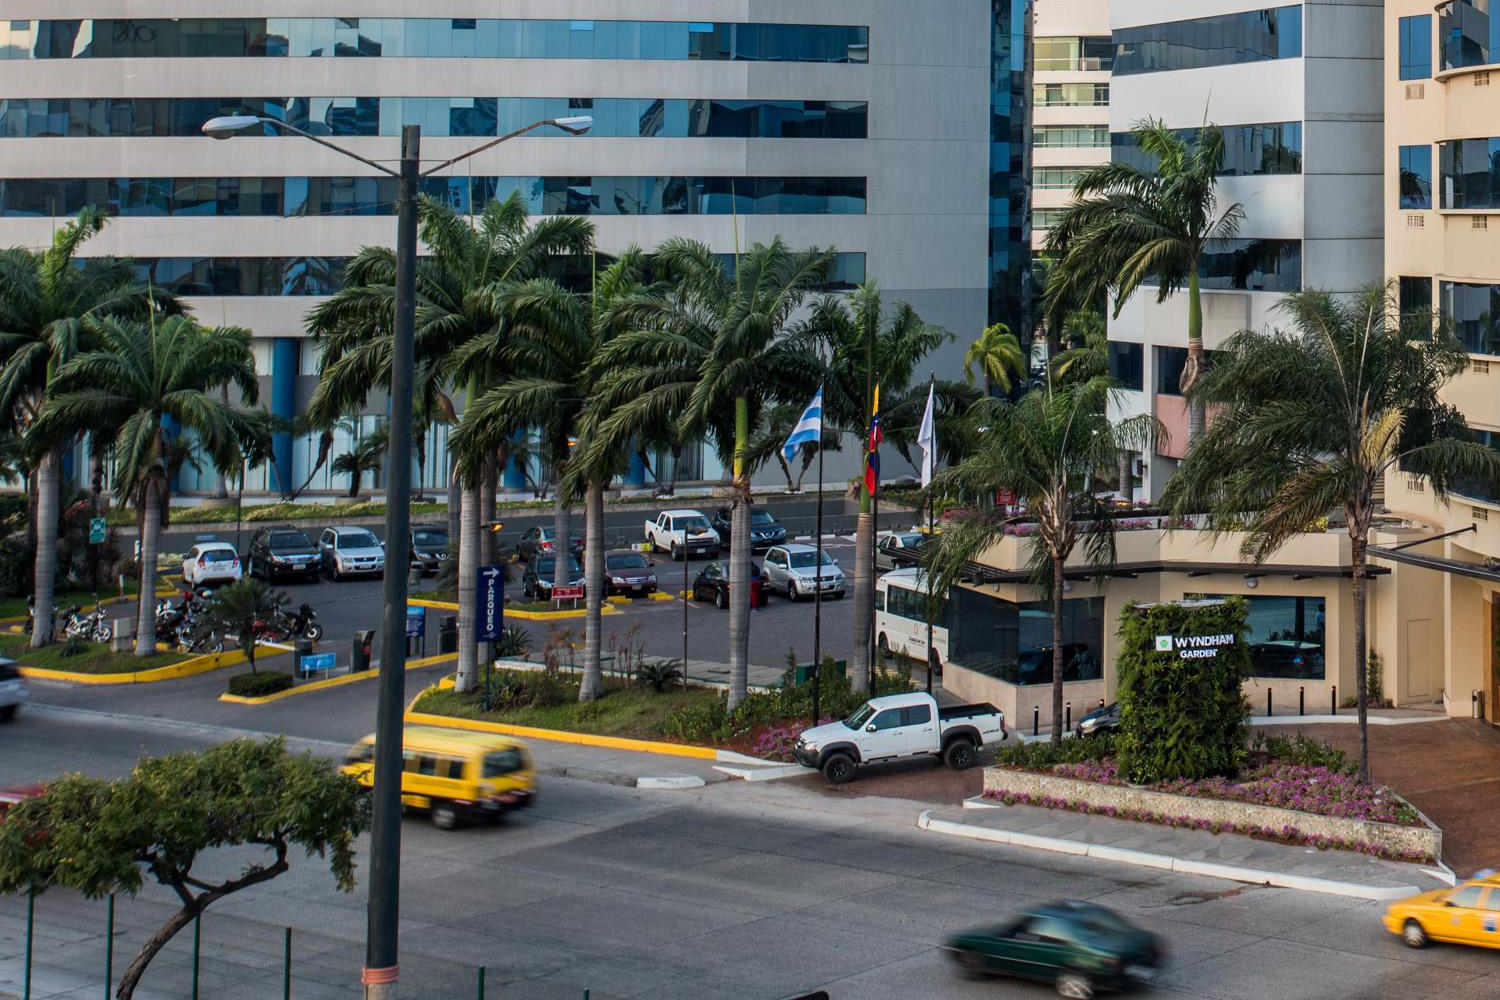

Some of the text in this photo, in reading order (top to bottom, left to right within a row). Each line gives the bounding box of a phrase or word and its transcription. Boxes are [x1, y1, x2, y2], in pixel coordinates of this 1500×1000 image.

[486, 578, 496, 631] PARQUEO
[1175, 634, 1234, 648] WYNDHAM
[1180, 649, 1217, 659] GARDEN
